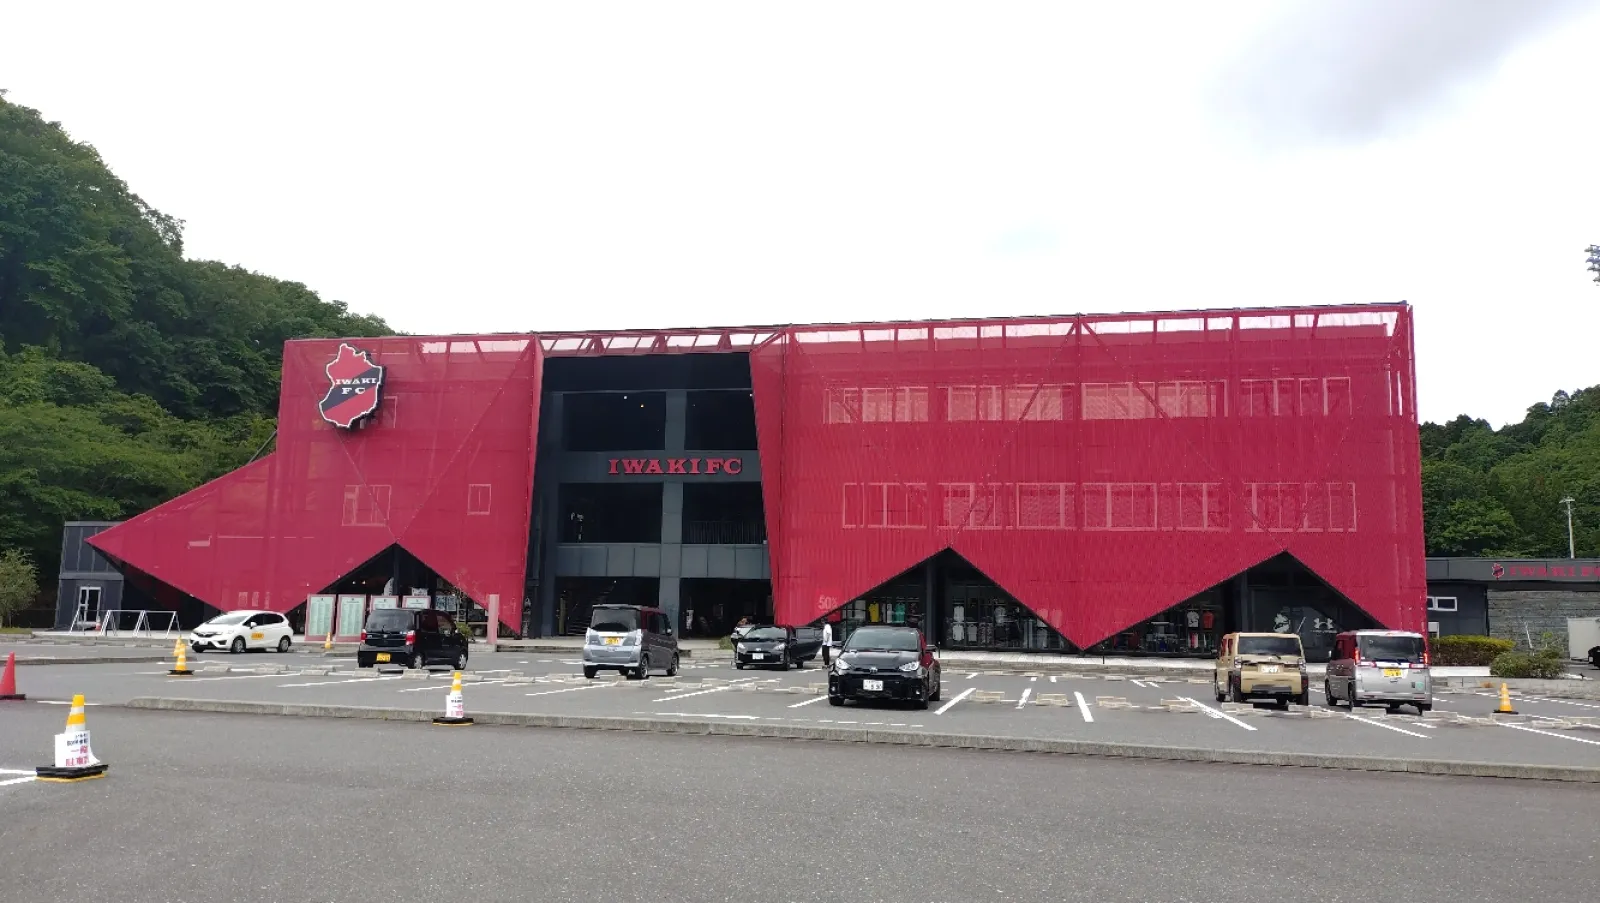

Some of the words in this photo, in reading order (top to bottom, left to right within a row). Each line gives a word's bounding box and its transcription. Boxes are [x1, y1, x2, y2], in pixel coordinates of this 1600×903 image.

[335, 377, 377, 385] IWAKI
[341, 387, 366, 395] FC
[608, 458, 701, 475] IWAKI
[704, 458, 742, 475] FC
[1508, 565, 1576, 577] IWAKI
